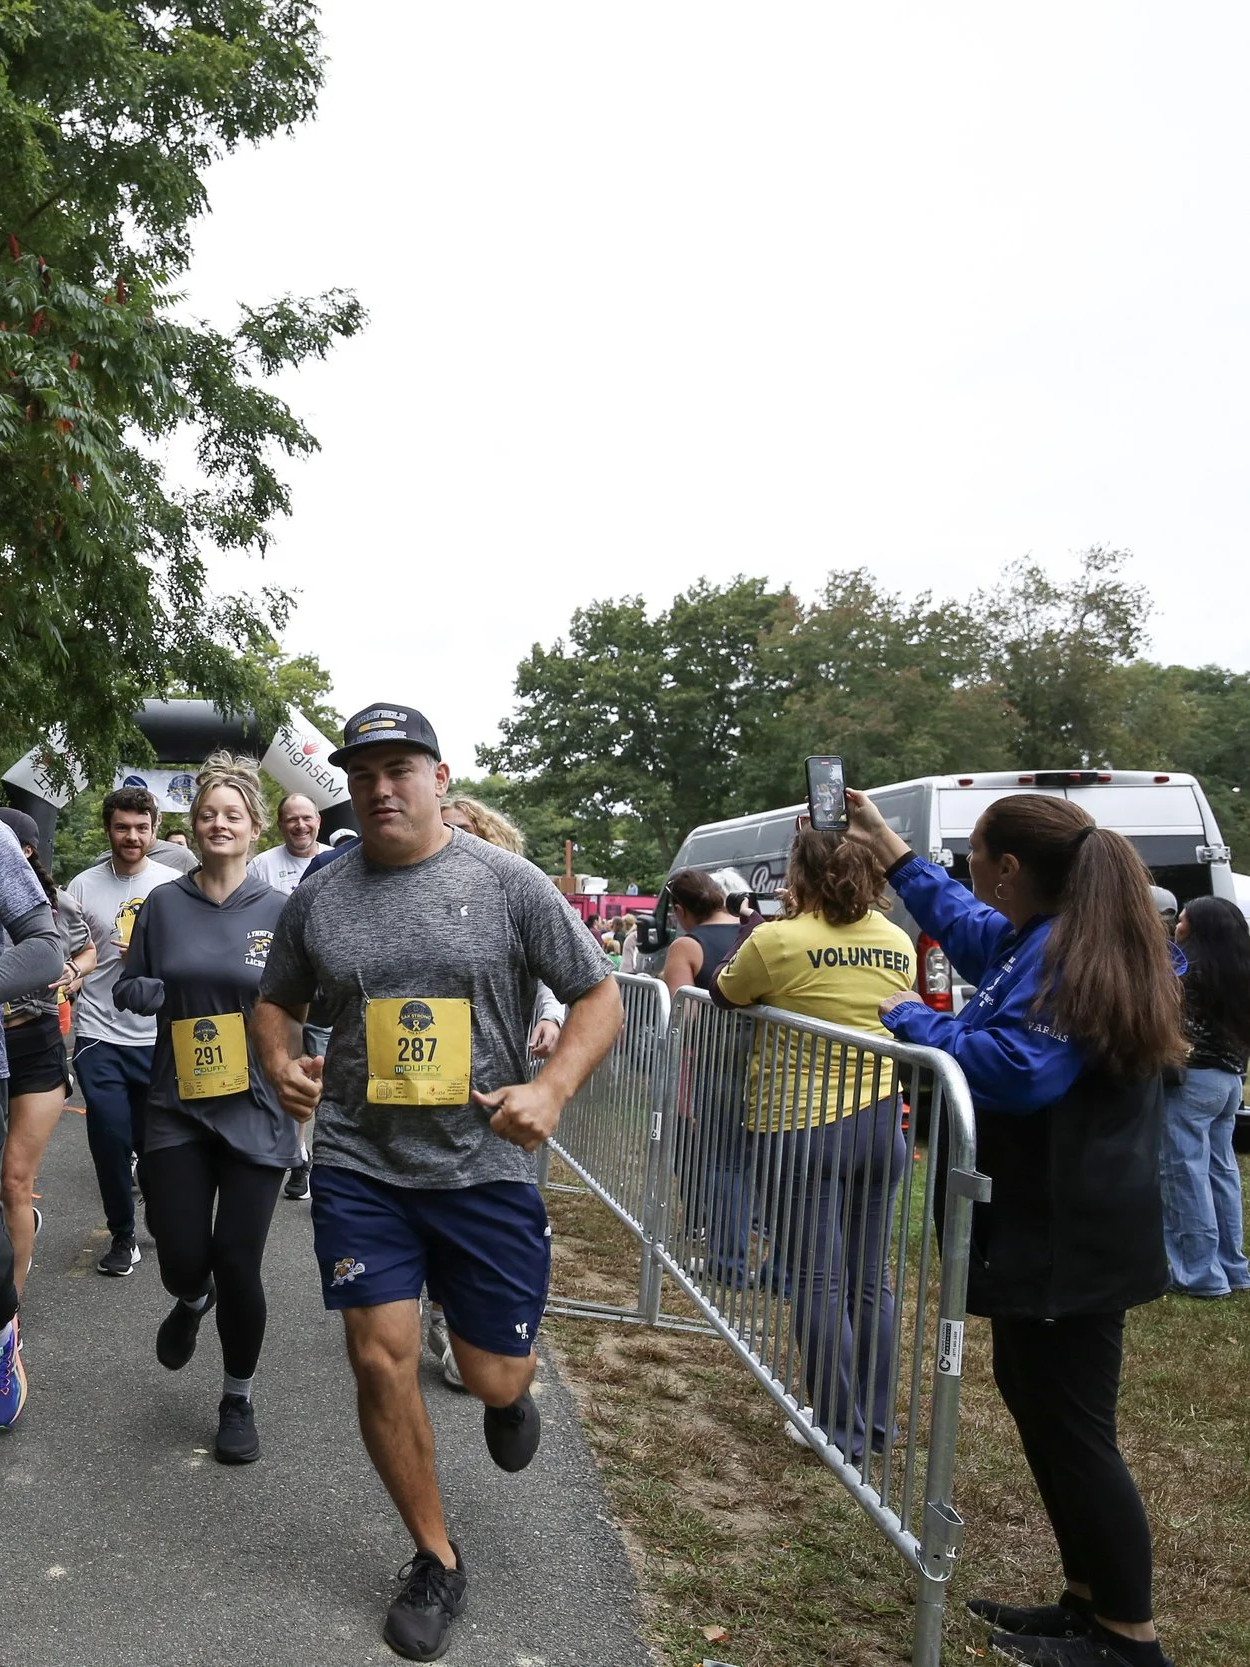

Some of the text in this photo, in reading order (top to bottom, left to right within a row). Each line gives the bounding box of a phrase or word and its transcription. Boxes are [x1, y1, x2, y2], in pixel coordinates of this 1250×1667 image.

[278, 737, 344, 798] High5EM
[244, 957, 266, 968] LACRO
[806, 946, 910, 974] VOLUNTEER
[194, 1045, 223, 1066] 291
[397, 1037, 438, 1062] 287
[200, 1064, 228, 1073] DUFFY
